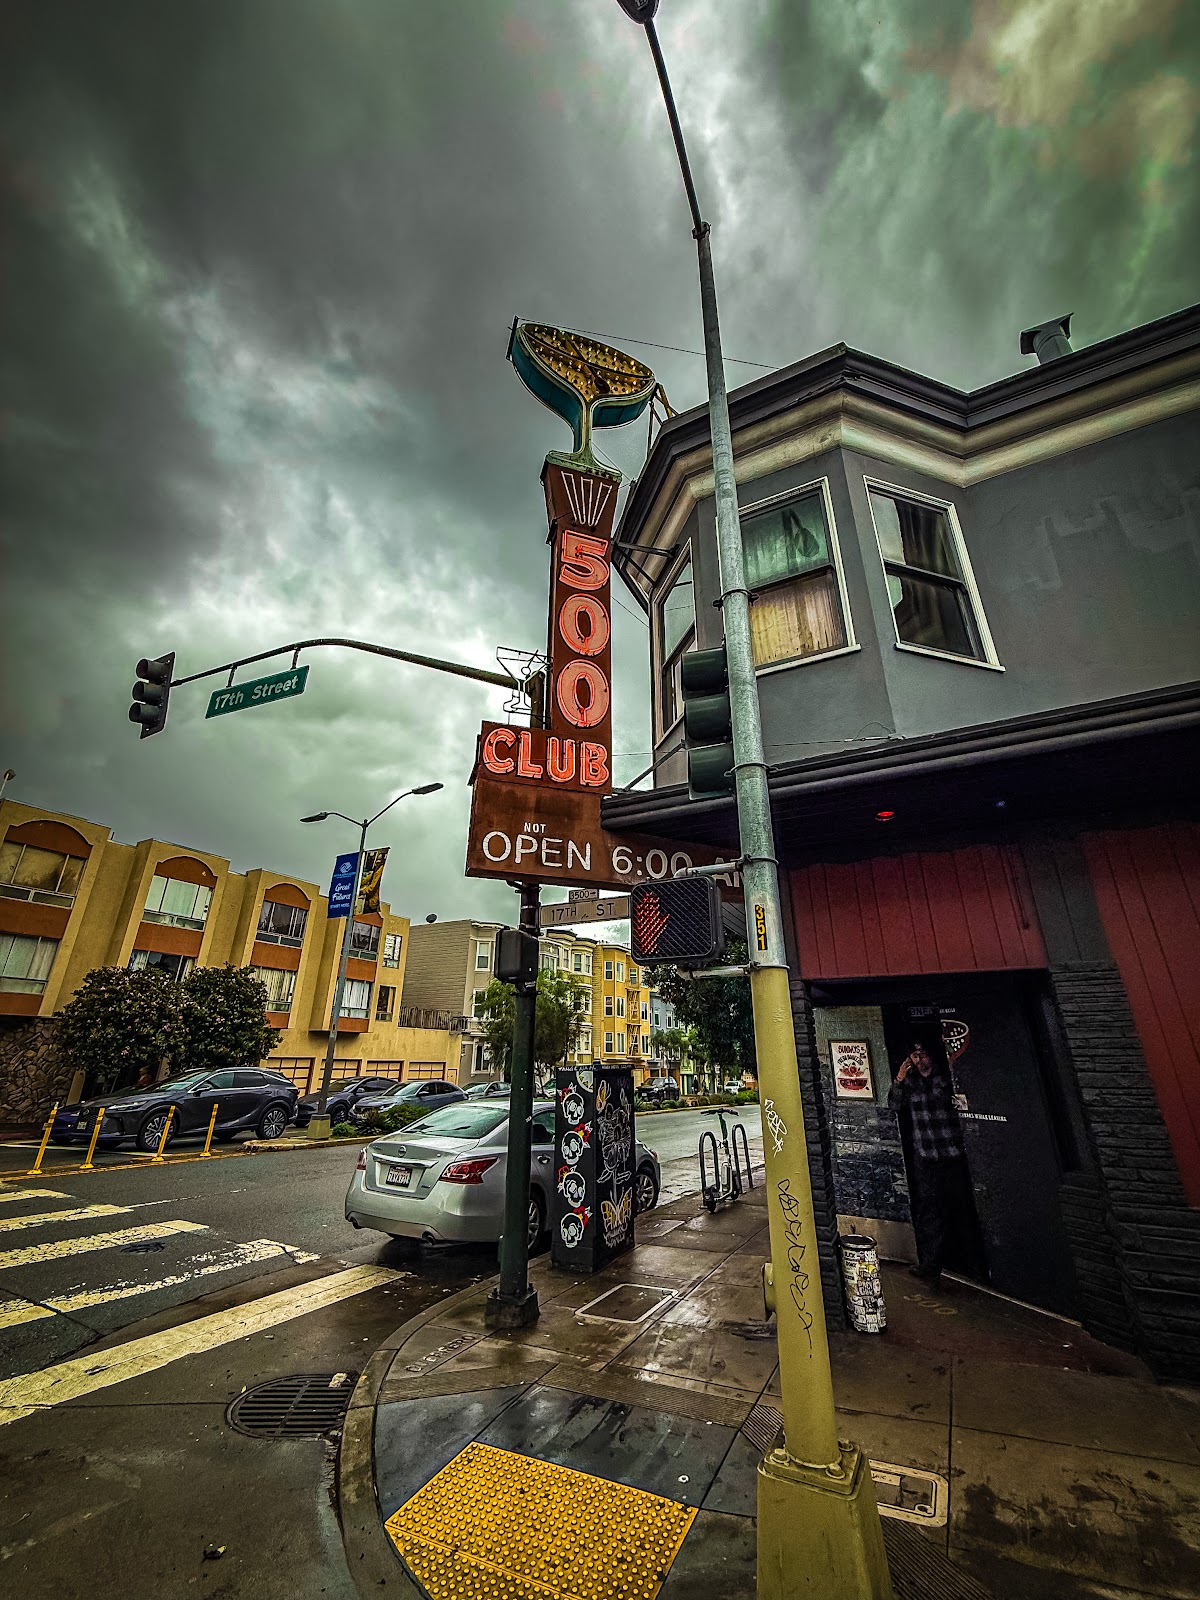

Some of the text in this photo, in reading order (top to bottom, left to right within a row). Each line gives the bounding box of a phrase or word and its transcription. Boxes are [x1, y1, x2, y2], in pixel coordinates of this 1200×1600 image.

[557, 530, 610, 727] 500
[214, 675, 299, 710] 17th Street
[482, 728, 610, 787] CLUB
[523, 822, 547, 834] NOT
[482, 831, 592, 871] OPEN
[611, 845, 693, 880] 6:00
[551, 902, 615, 922] 17TH ST
[755, 905, 766, 951] 351
